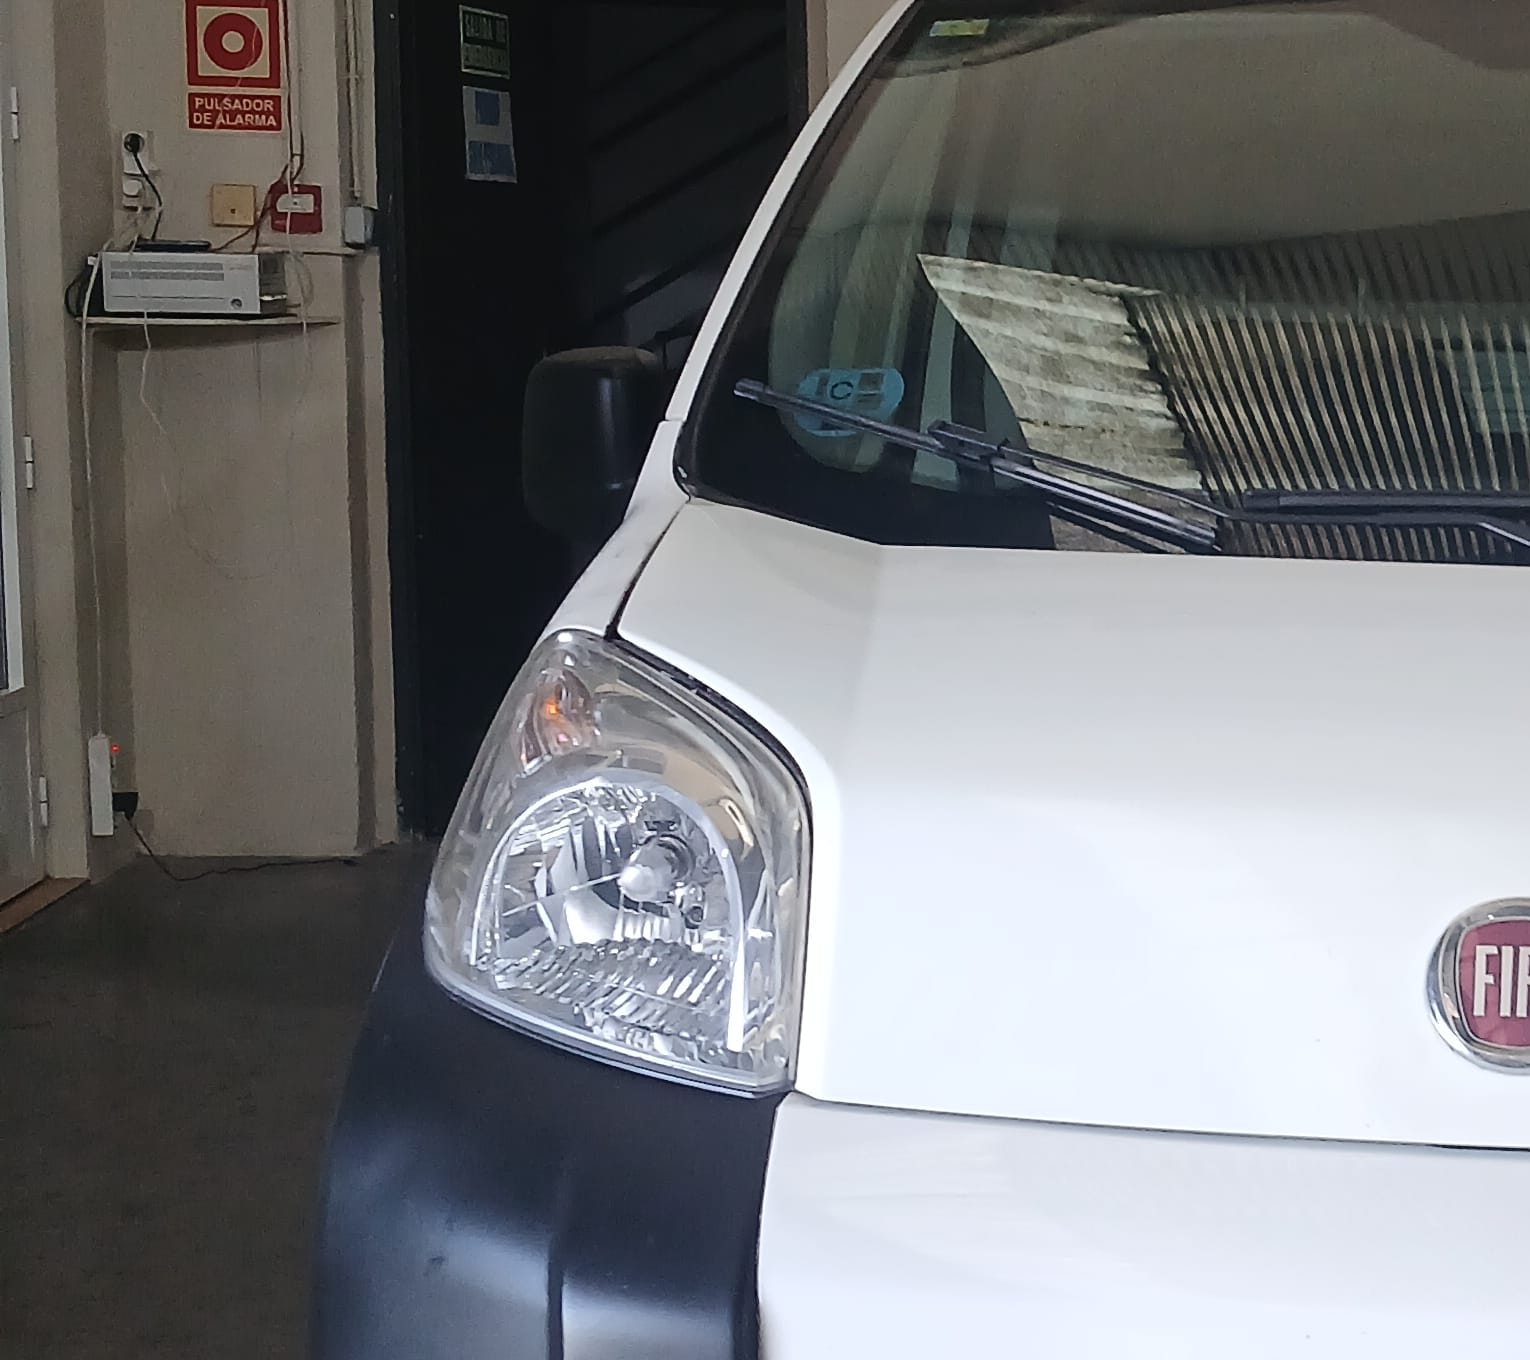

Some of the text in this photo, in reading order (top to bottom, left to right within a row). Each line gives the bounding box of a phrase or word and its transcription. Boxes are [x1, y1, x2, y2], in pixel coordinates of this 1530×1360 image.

[194, 97, 274, 112] PULSADOR
[193, 113, 277, 127] DE ALARMA
[830, 381, 854, 400] C
